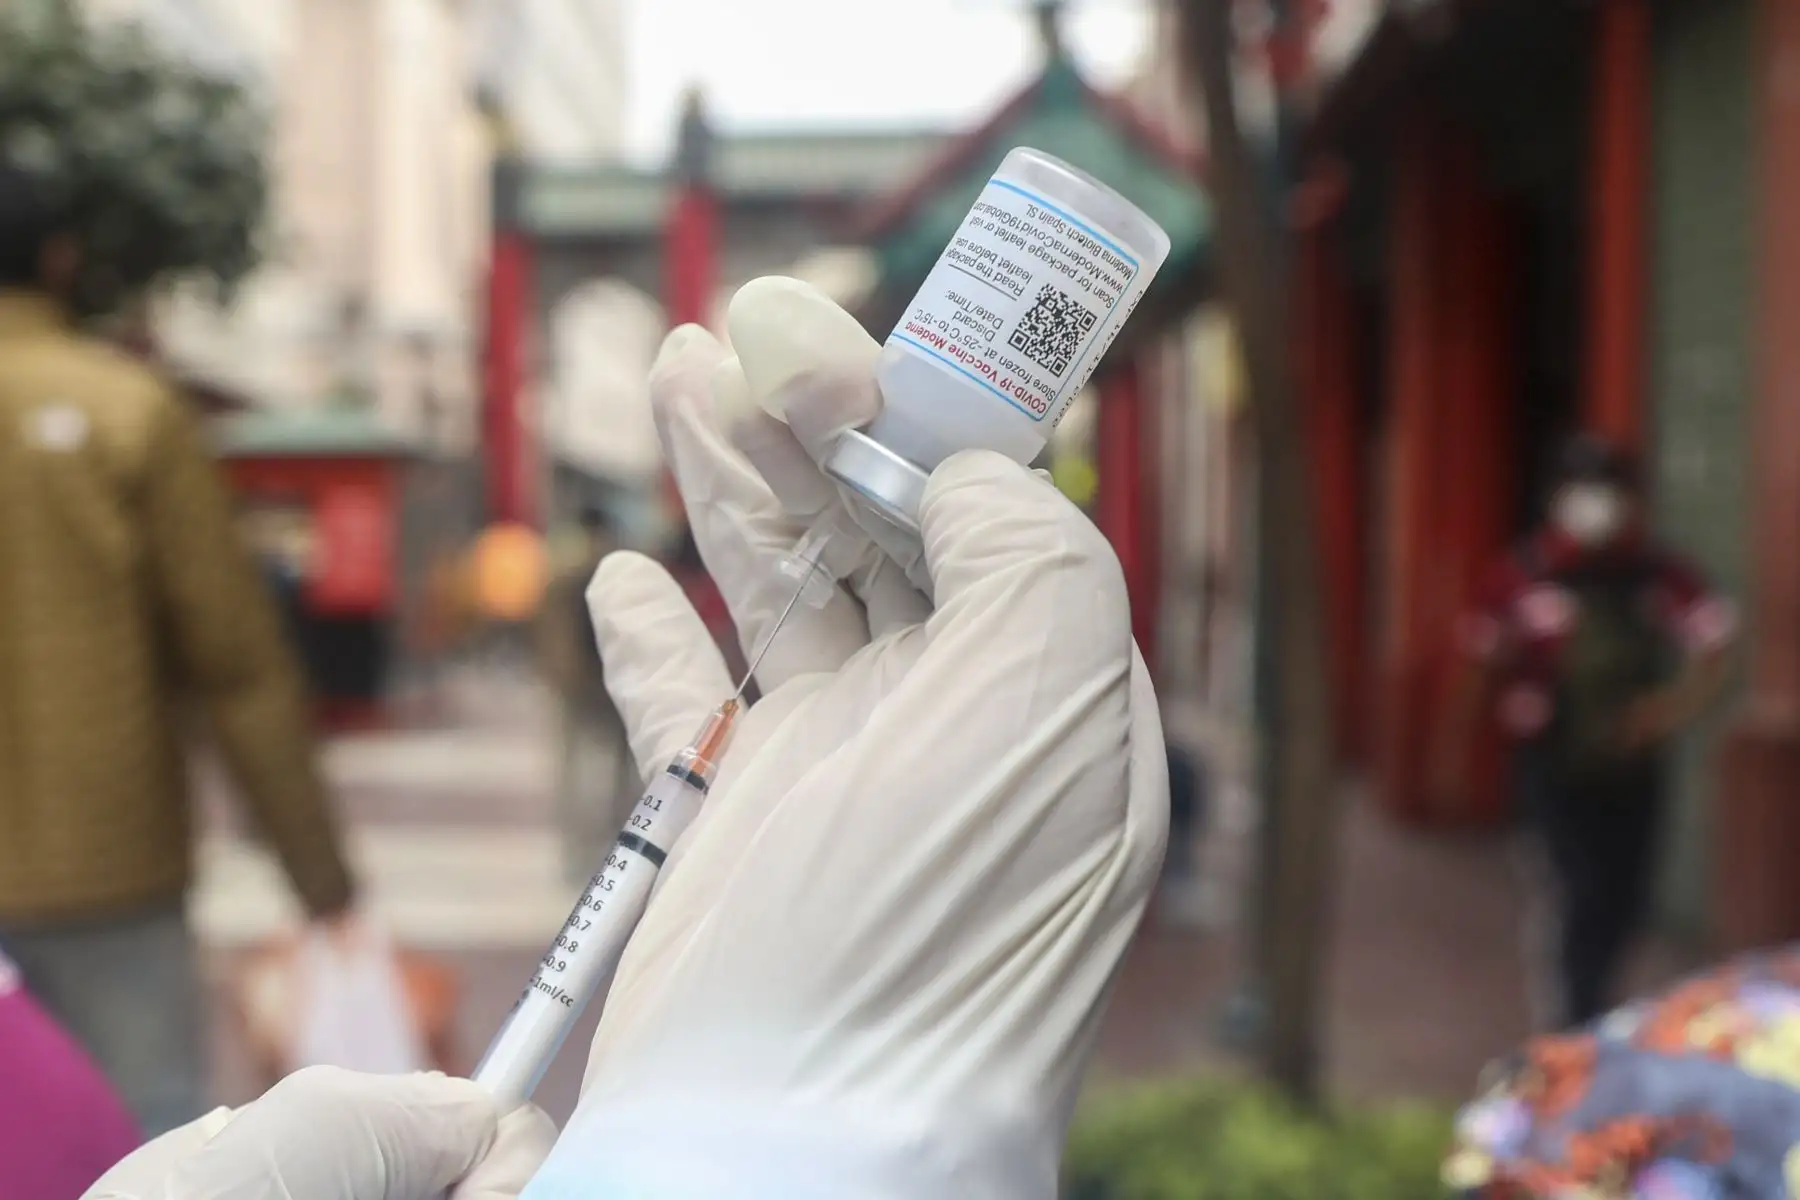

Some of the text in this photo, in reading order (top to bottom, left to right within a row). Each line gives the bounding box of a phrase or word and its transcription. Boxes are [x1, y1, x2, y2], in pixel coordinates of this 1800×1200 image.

[983, 221, 995, 231] or
[993, 225, 1027, 251] leaflet
[1025, 203, 1133, 280] Moderna Biotech Spain SL
[967, 241, 998, 264] before
[975, 261, 993, 278] the
[997, 256, 1033, 285] leaflet
[991, 271, 1025, 296] Read
[1075, 275, 1093, 292] for
[1092, 285, 1114, 308] Scan
[944, 289, 1004, 330] Date/Time:
[937, 319, 949, 333] to
[951, 310, 996, 342] Discard
[983, 346, 998, 359] at
[904, 321, 1046, 414] COVID-19 Vaccine Moderna
[998, 355, 1032, 384] frozen
[1032, 378, 1056, 401] Store
[643, 795, 662, 811] 0.1
[631, 815, 652, 831] 0.2
[608, 855, 628, 871] 0.4
[595, 875, 615, 891] 0.5
[583, 892, 603, 911] 0.6
[570, 913, 591, 931] 0.7
[558, 933, 578, 953] 0.8
[545, 956, 566, 972] 0.9
[534, 977, 573, 1007] 1ml/cc
